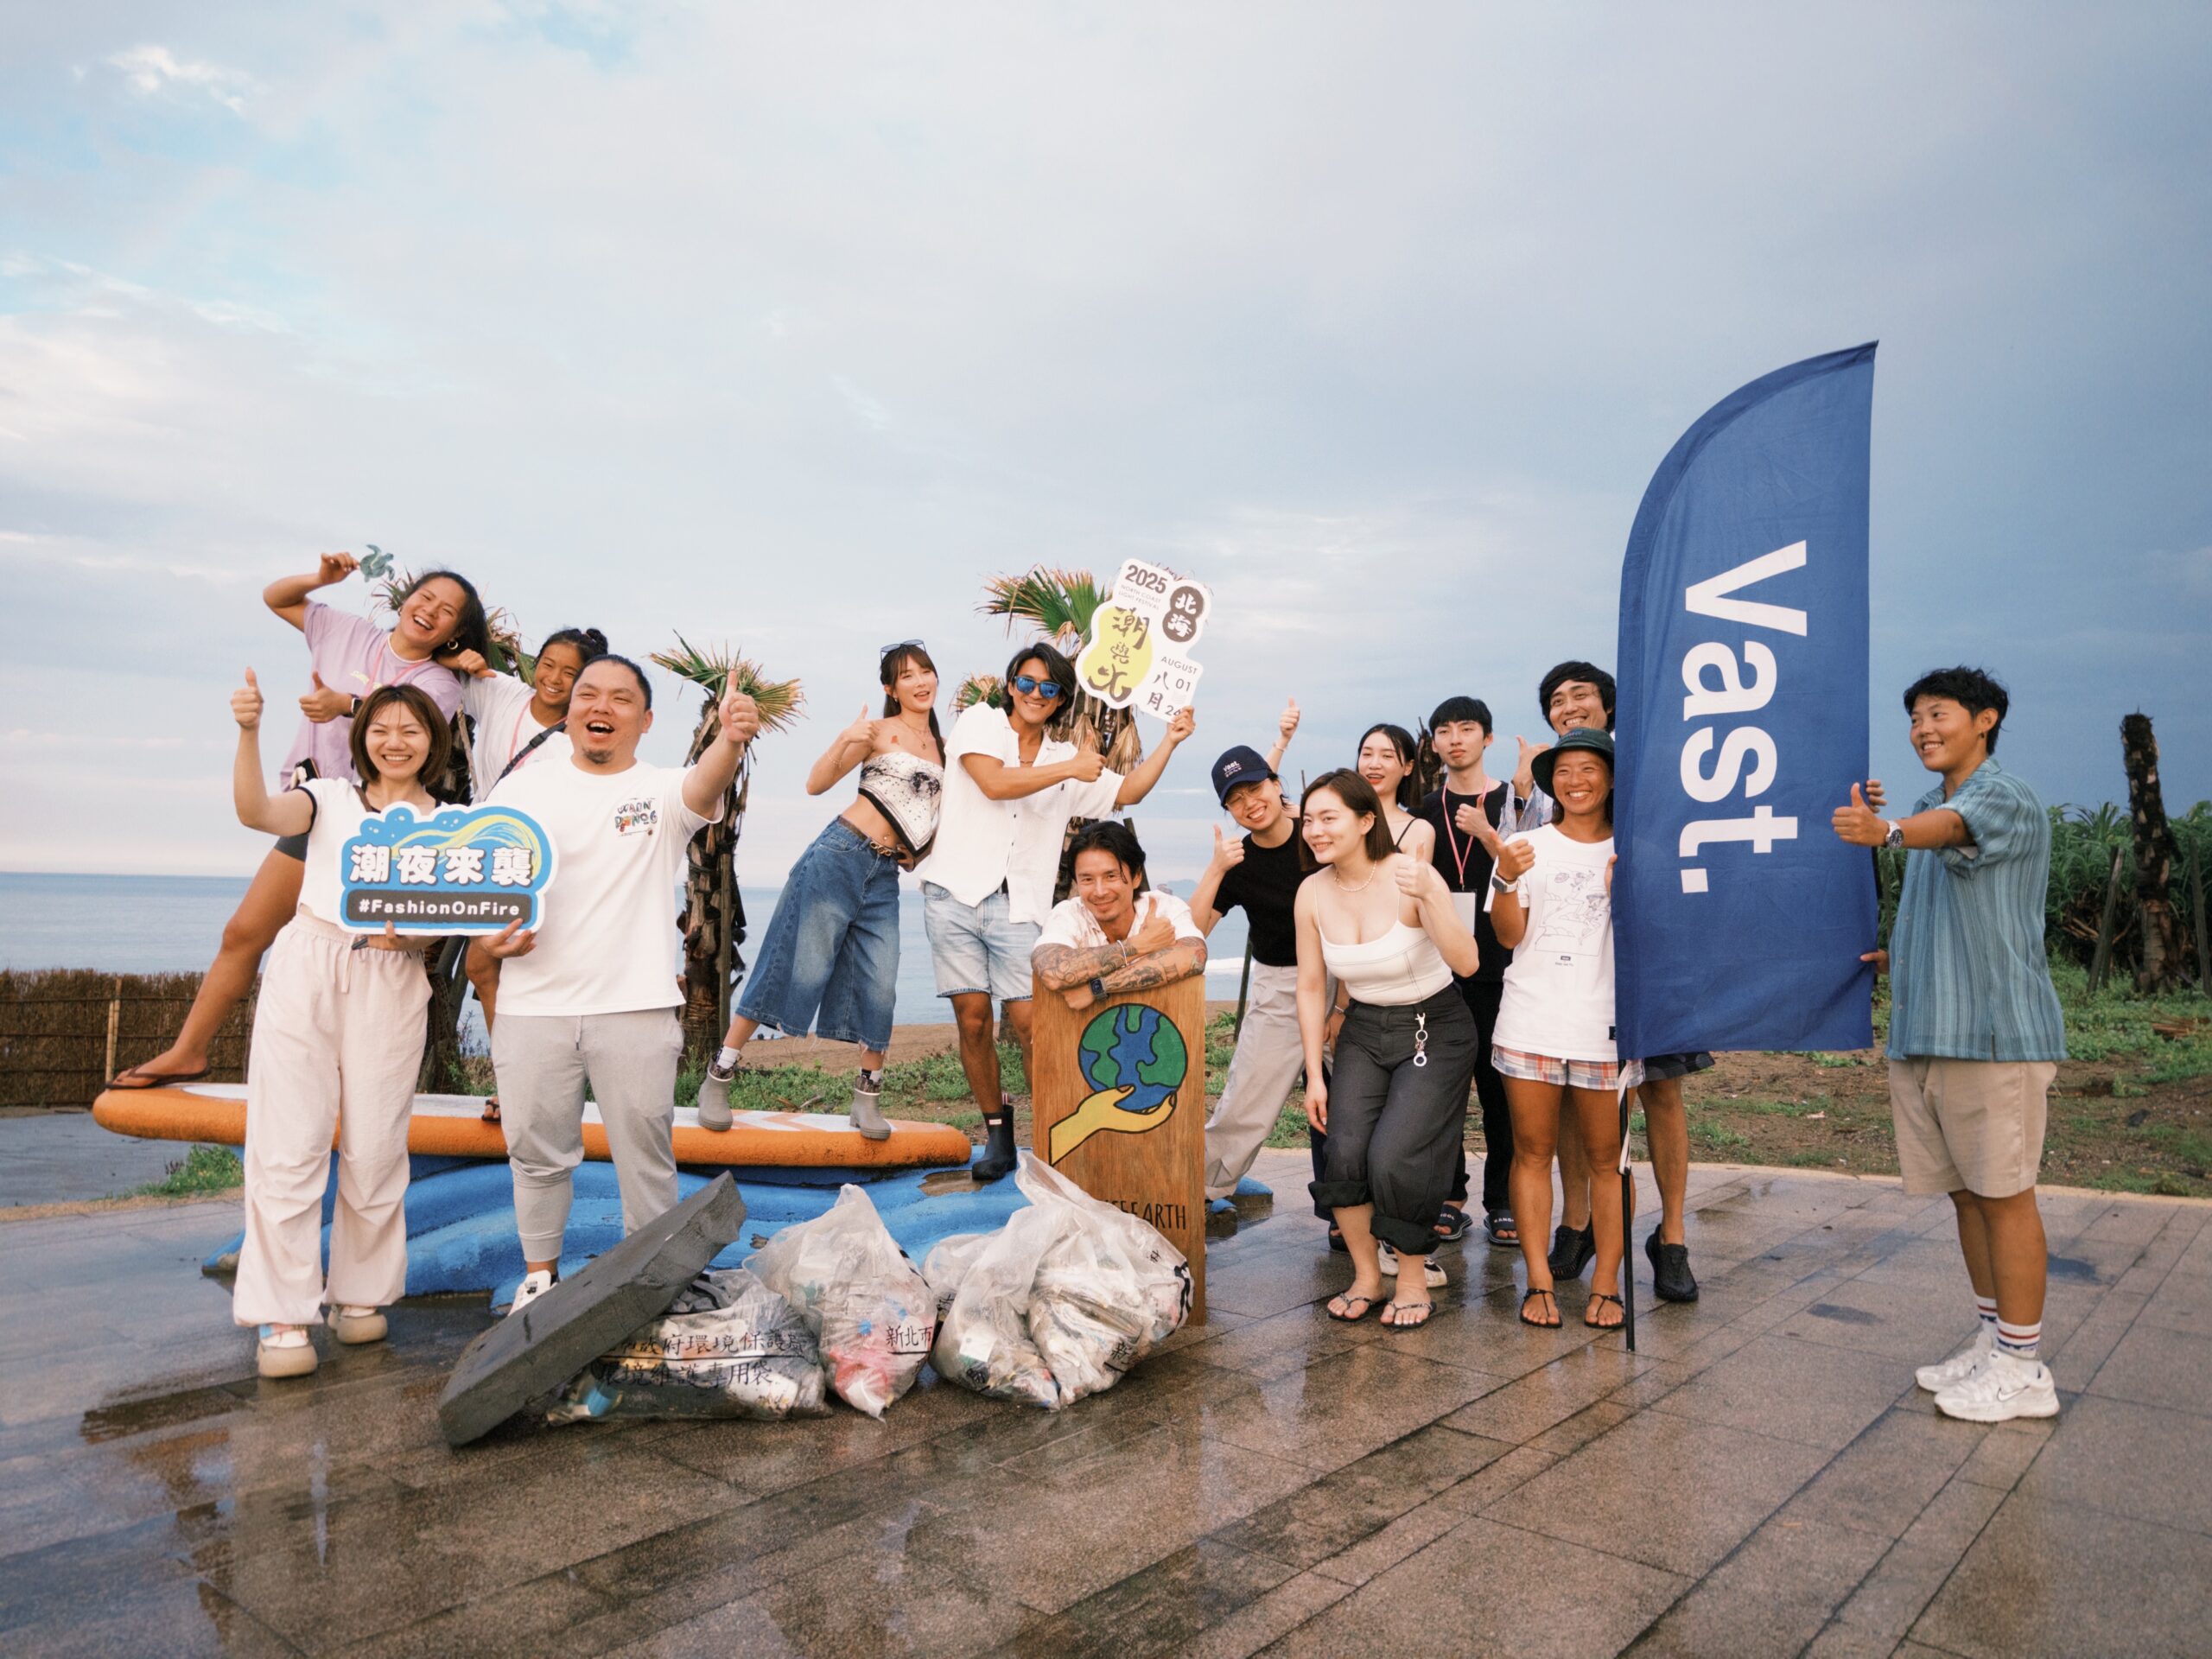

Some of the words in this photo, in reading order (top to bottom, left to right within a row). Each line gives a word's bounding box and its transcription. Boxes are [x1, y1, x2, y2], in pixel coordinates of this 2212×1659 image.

[1125, 564, 1167, 594] 2025
[1167, 594, 1198, 637] 北海
[1161, 657, 1198, 675] AUGUST
[1147, 671, 1169, 711] 八月
[1175, 678, 1191, 691] 01
[1679, 540, 1807, 893] Vast.
[349, 843, 533, 887] 潮夜來襲
[359, 899, 520, 916] #FashionOnFire
[886, 1325, 933, 1349] 新北市
